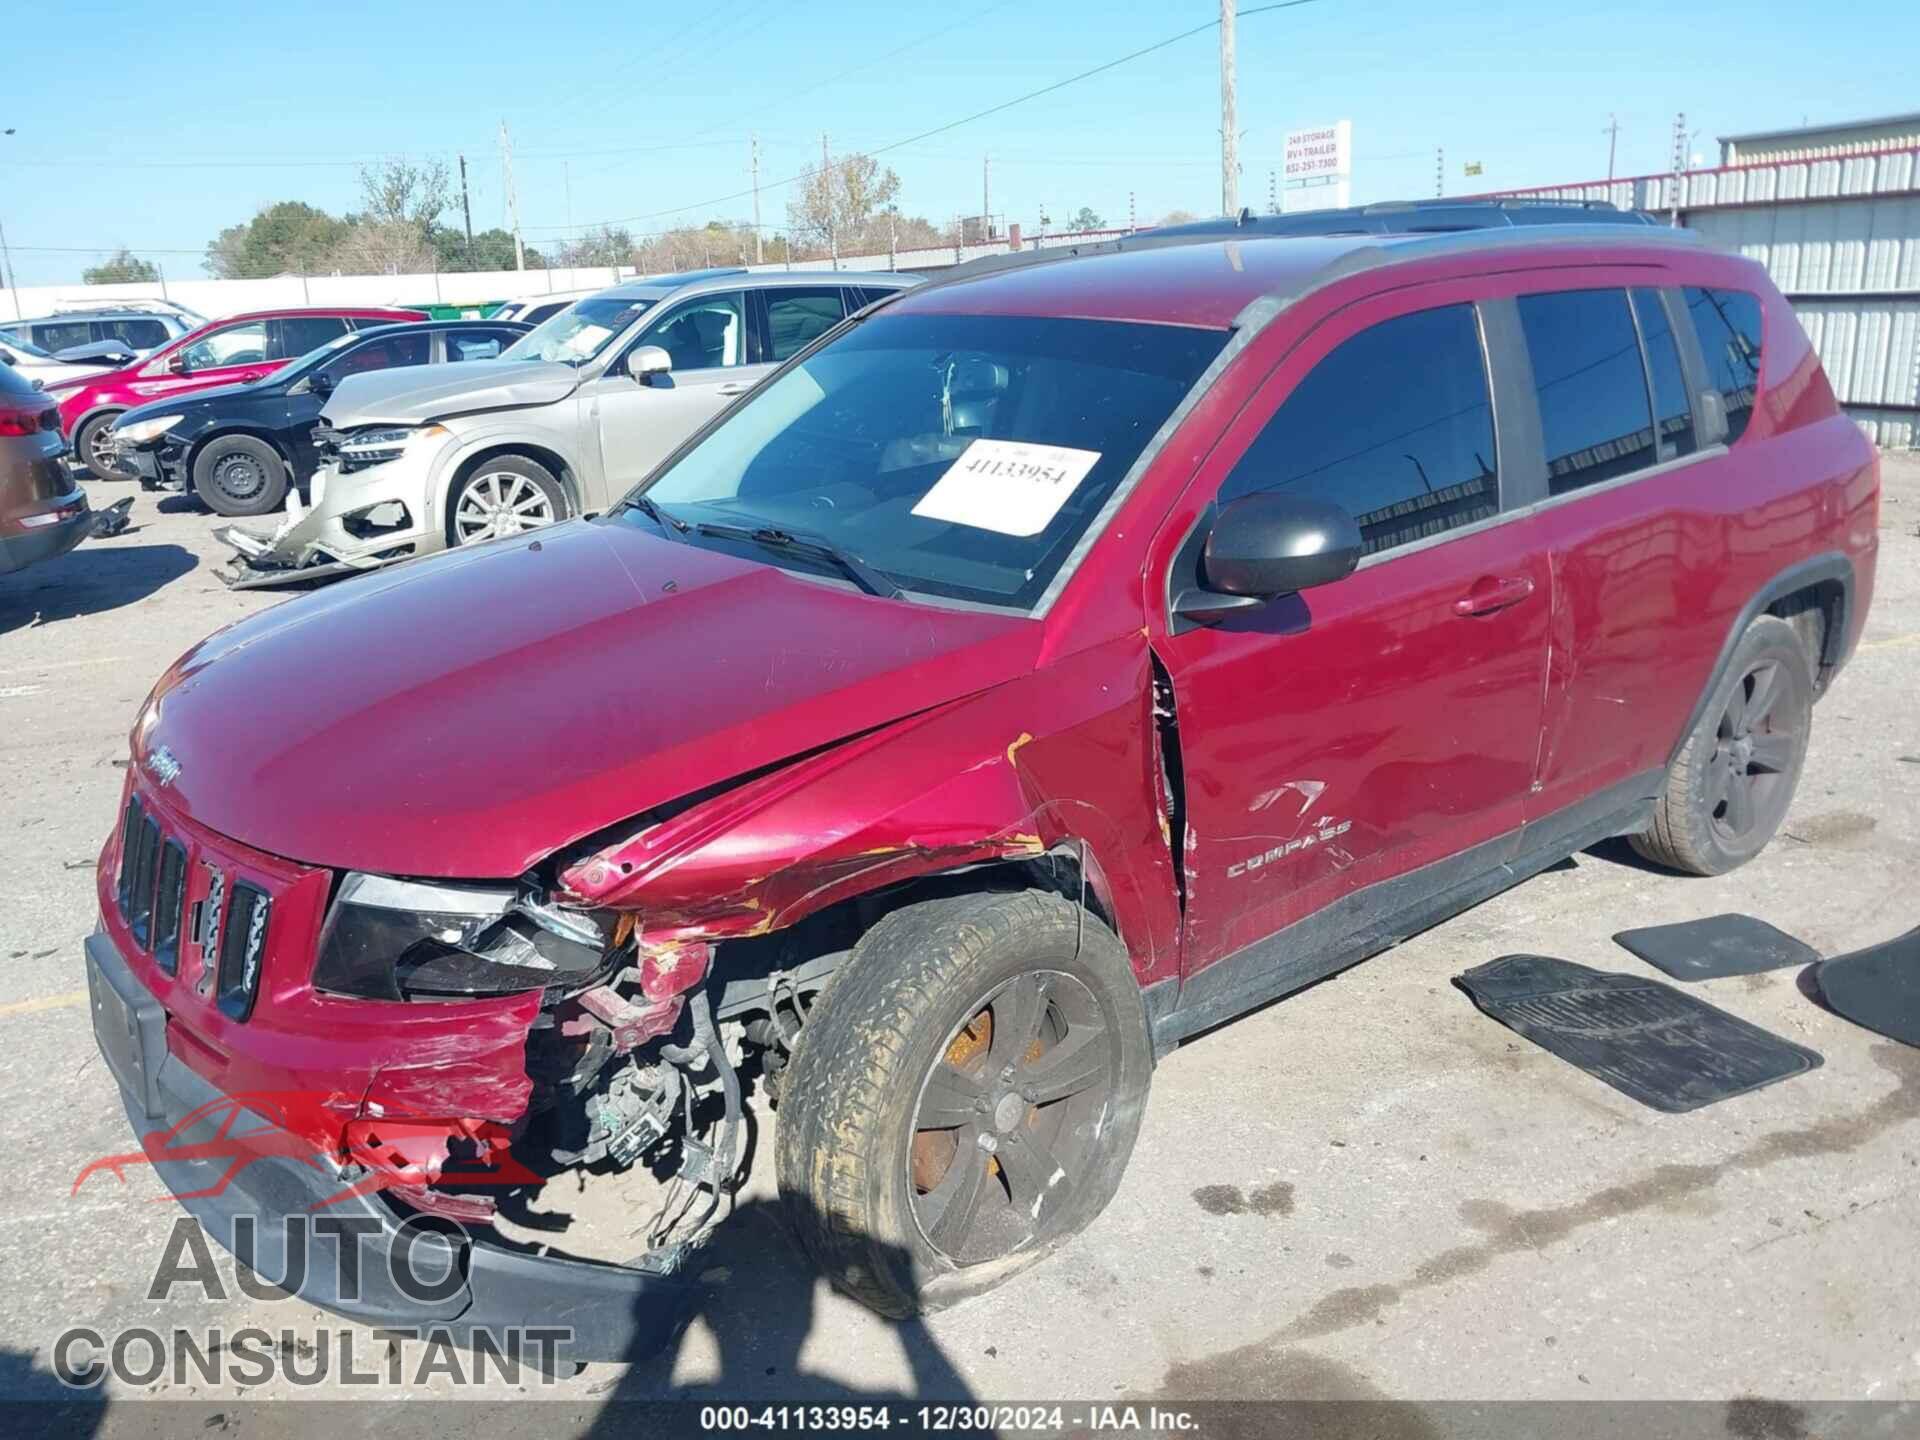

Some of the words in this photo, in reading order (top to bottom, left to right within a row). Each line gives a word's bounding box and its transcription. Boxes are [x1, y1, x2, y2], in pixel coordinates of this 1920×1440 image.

[1303, 129, 1336, 144] STORAGE
[1287, 149, 1298, 160] RV
[1304, 143, 1337, 157] TRAILER
[966, 459, 1068, 484] 41133954
[1226, 820, 1353, 878] COMPASS
